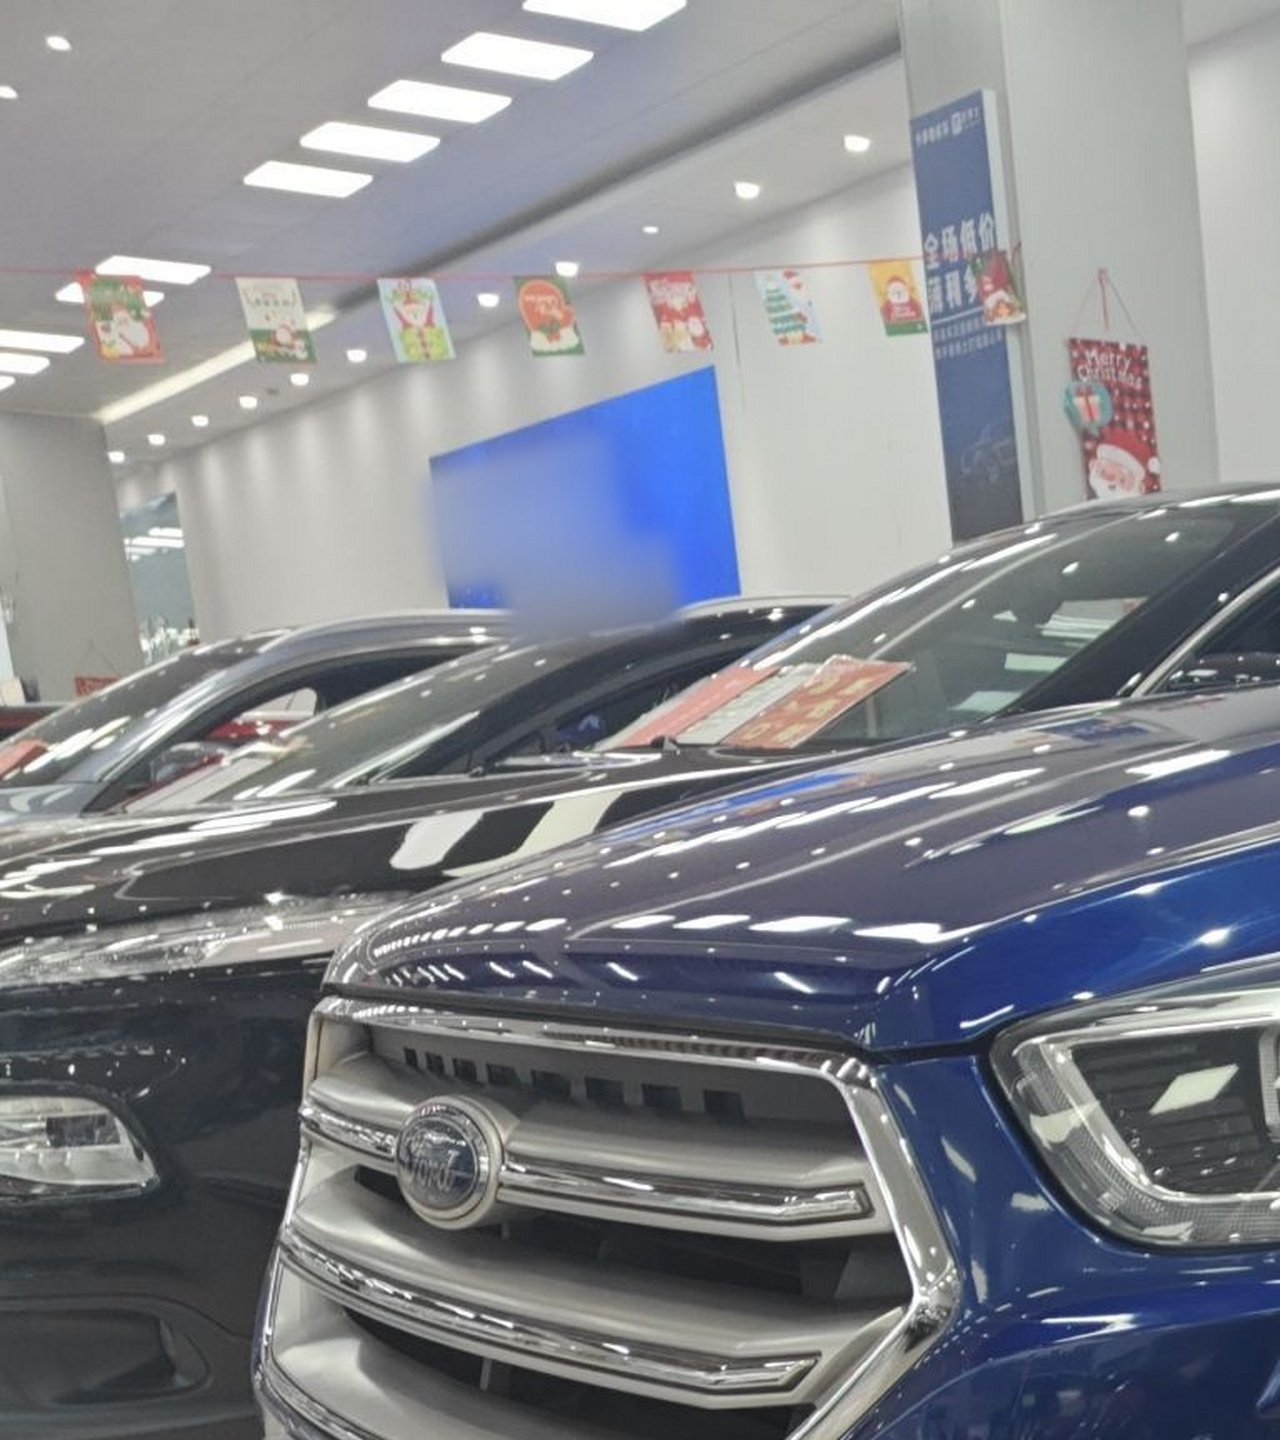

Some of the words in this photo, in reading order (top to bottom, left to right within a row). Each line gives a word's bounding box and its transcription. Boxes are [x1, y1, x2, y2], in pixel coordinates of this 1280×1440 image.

[924, 213, 995, 269] 全场低价
[1077, 364, 1143, 390] Christmas
[1083, 347, 1132, 371] Merry
[404, 1129, 462, 1193] Ford
